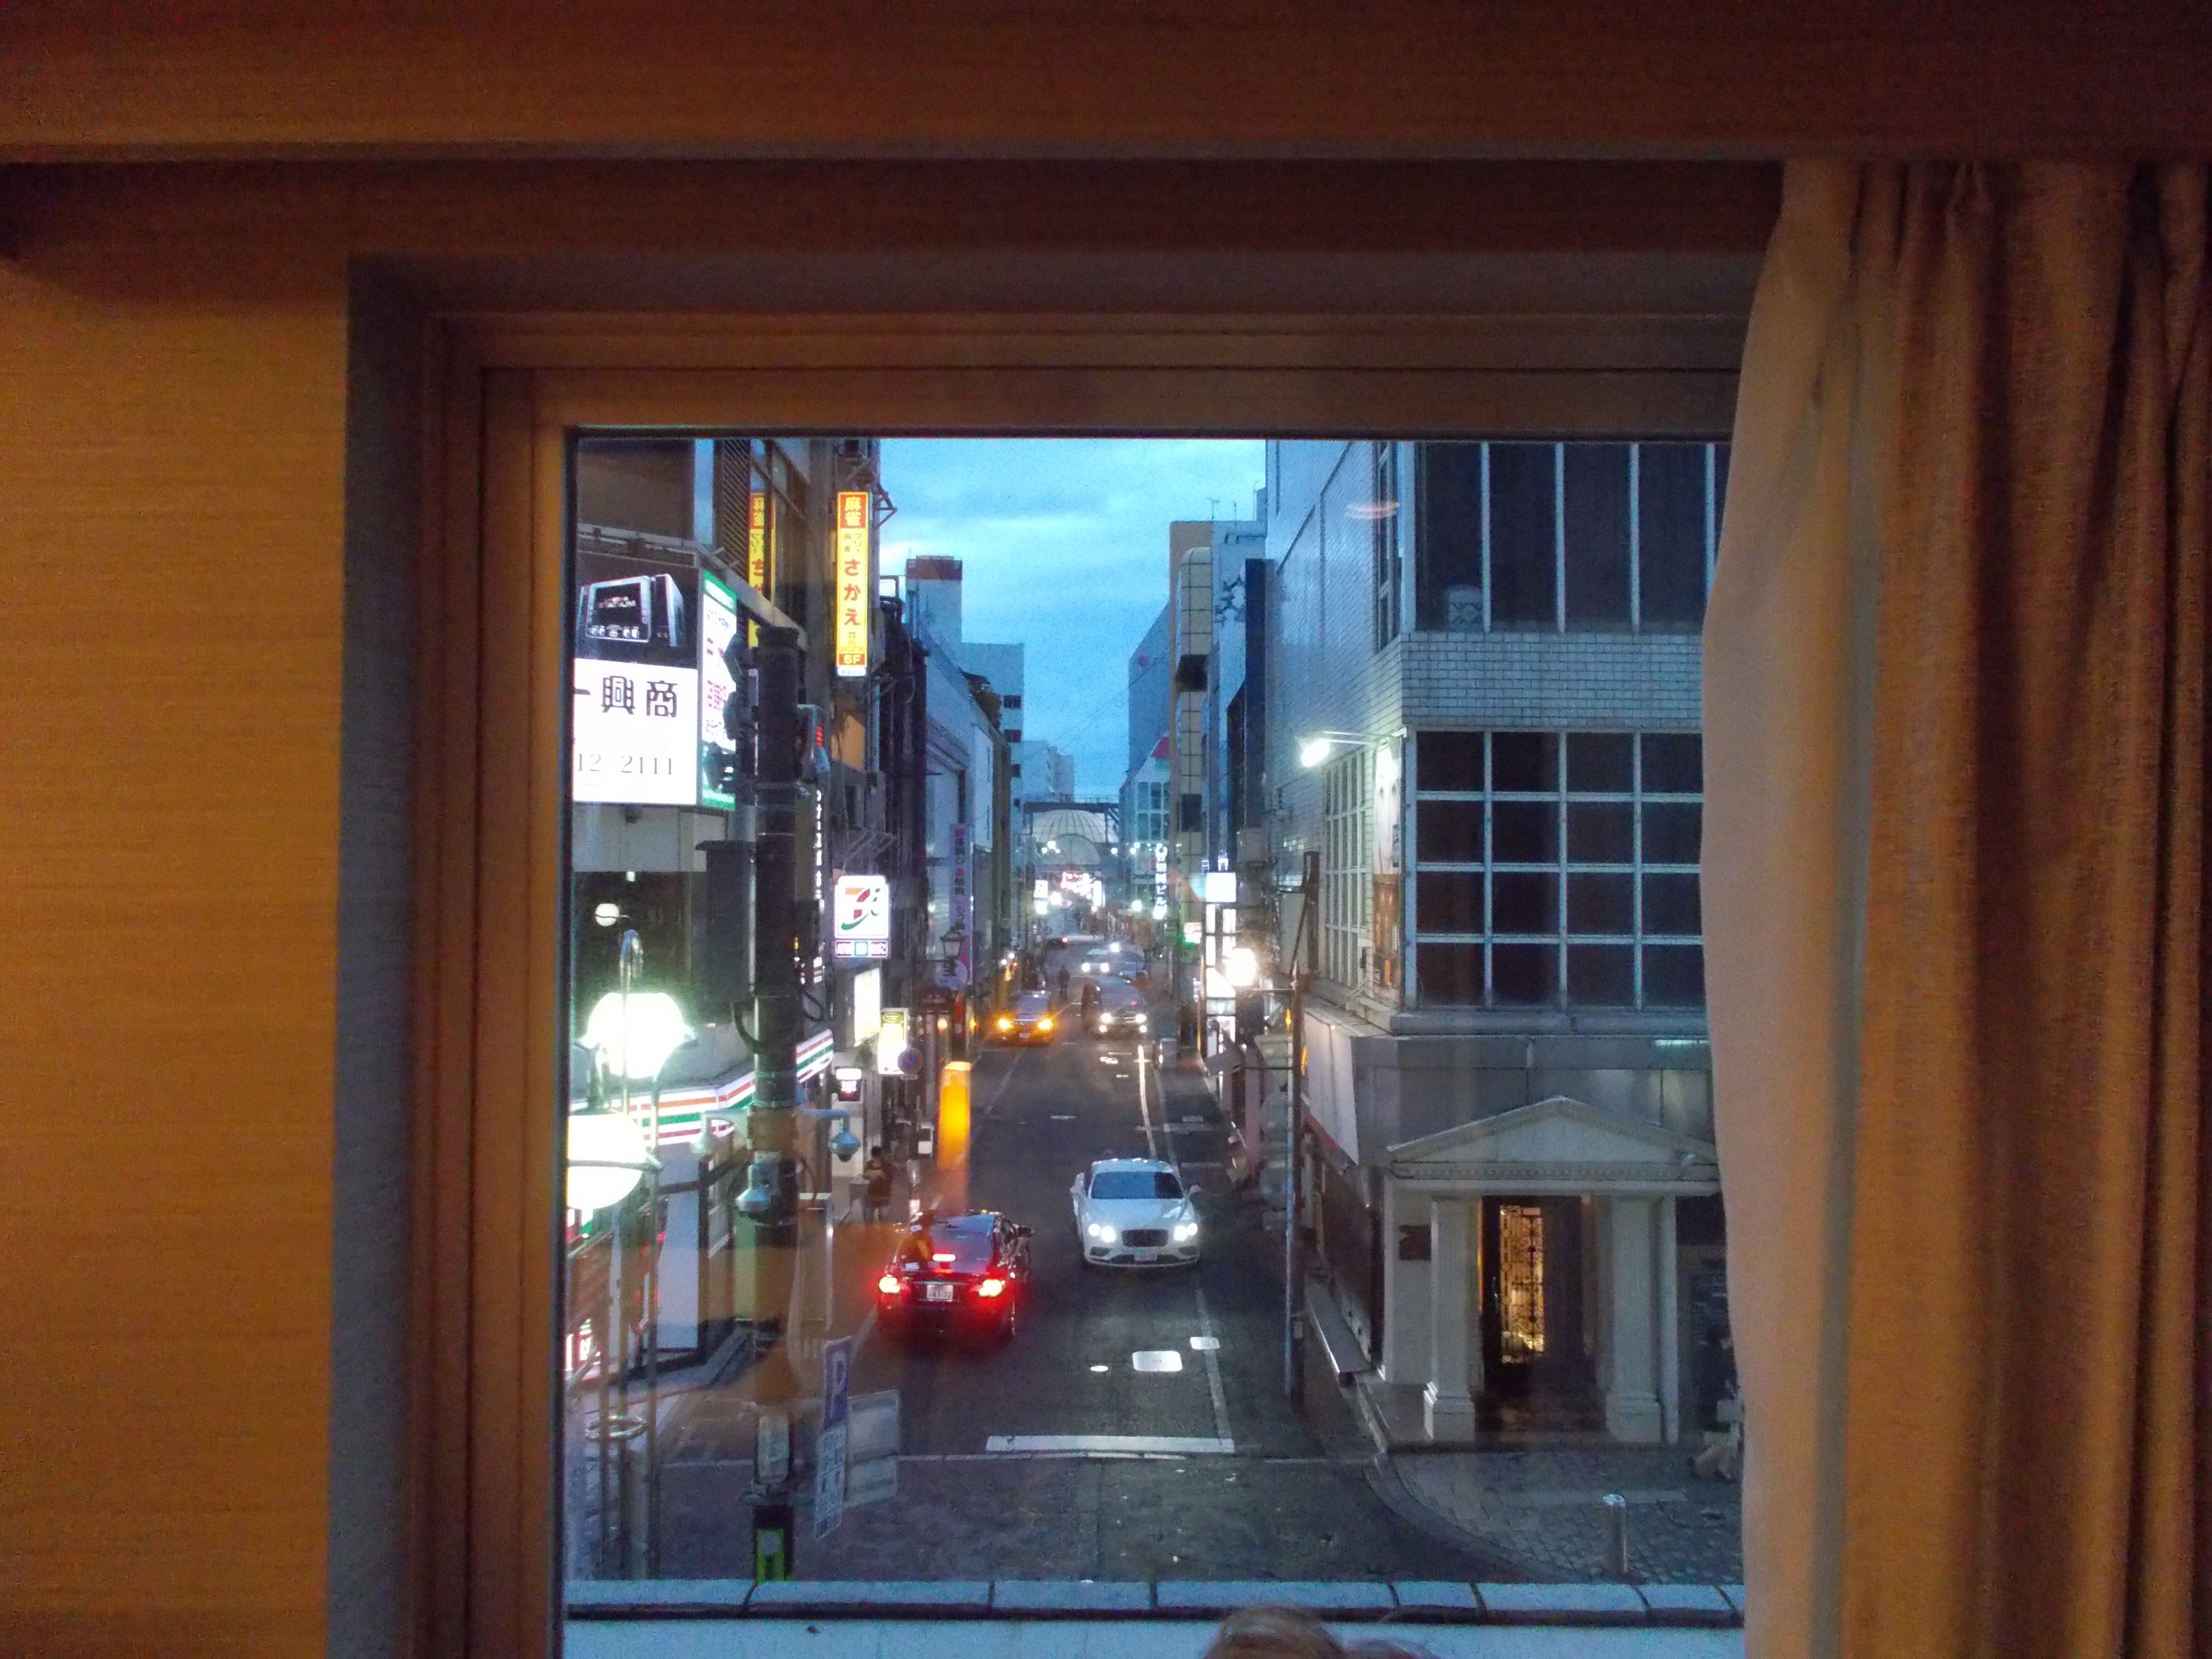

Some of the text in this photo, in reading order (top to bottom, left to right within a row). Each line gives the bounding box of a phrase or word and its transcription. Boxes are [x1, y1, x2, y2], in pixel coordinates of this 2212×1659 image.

[843, 558, 861, 626] さかえ
[843, 654, 861, 664] 5F
